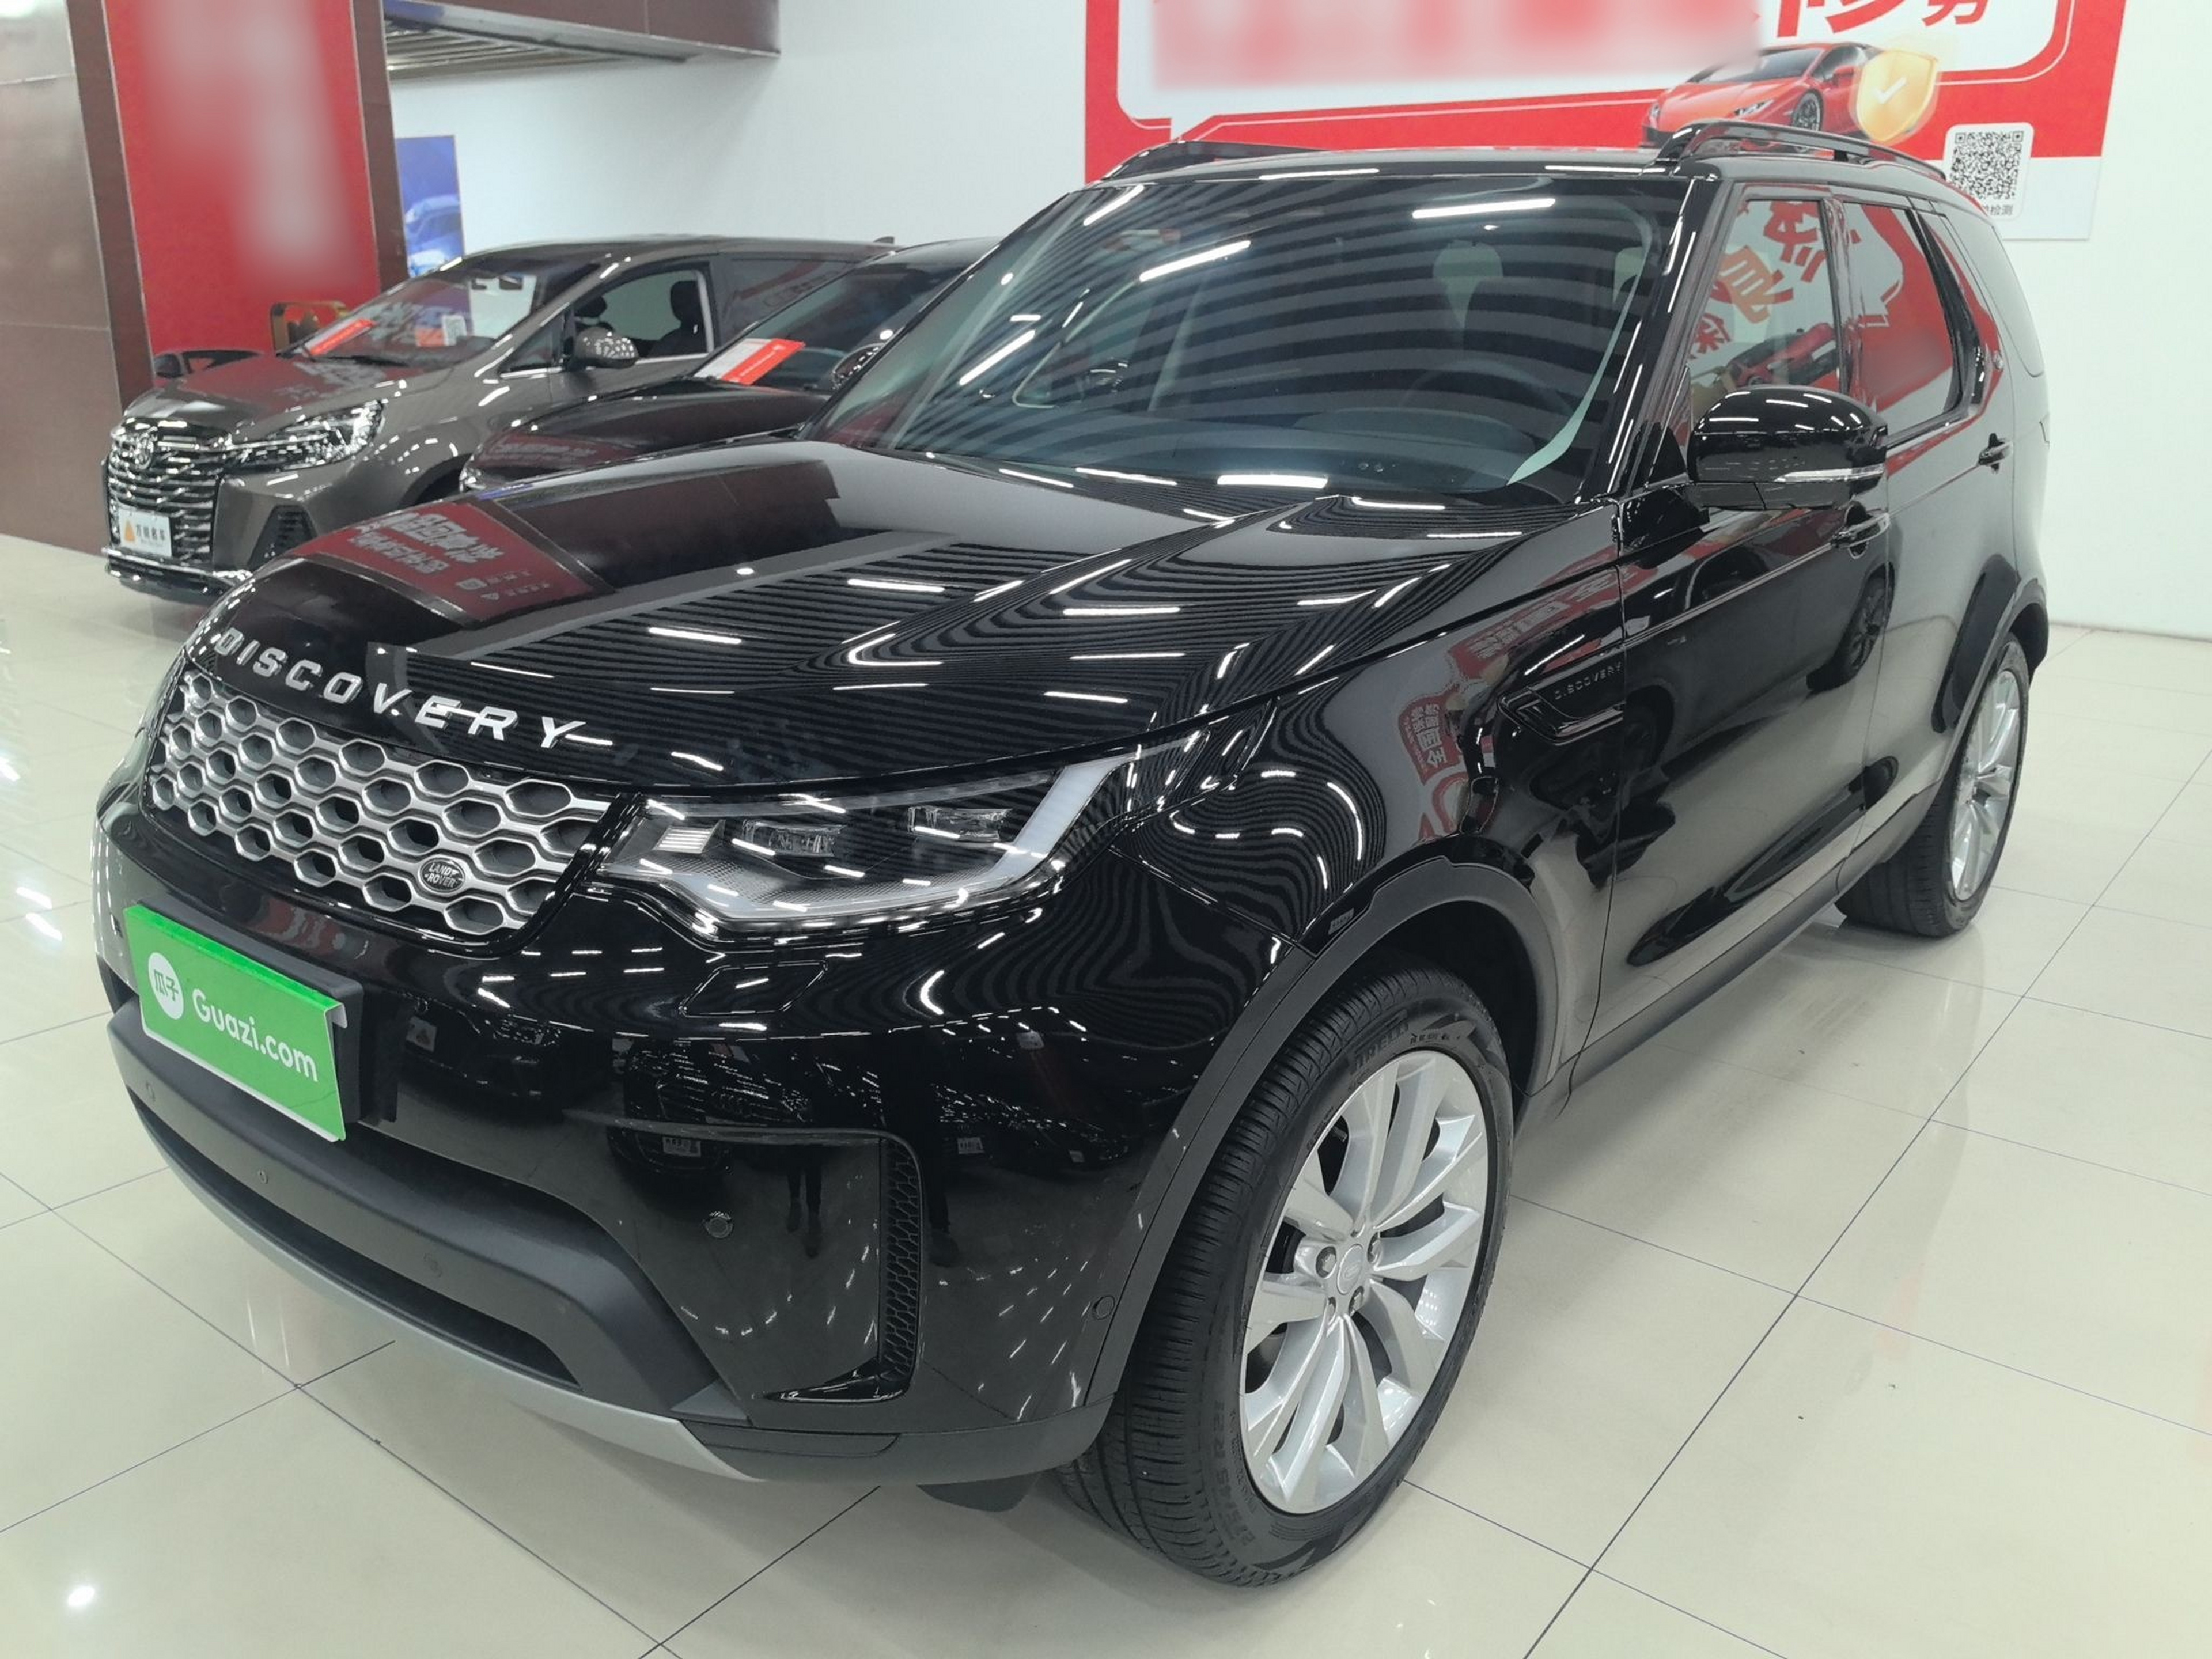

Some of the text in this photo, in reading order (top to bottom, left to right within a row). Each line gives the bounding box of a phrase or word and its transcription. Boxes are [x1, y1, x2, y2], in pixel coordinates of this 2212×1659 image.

[213, 626, 586, 749] DISCOVERY
[427, 872, 456, 888] ROVER
[429, 862, 453, 876] LAND
[153, 969, 179, 1002] 瓜子
[192, 988, 318, 1082] Guazi.com
